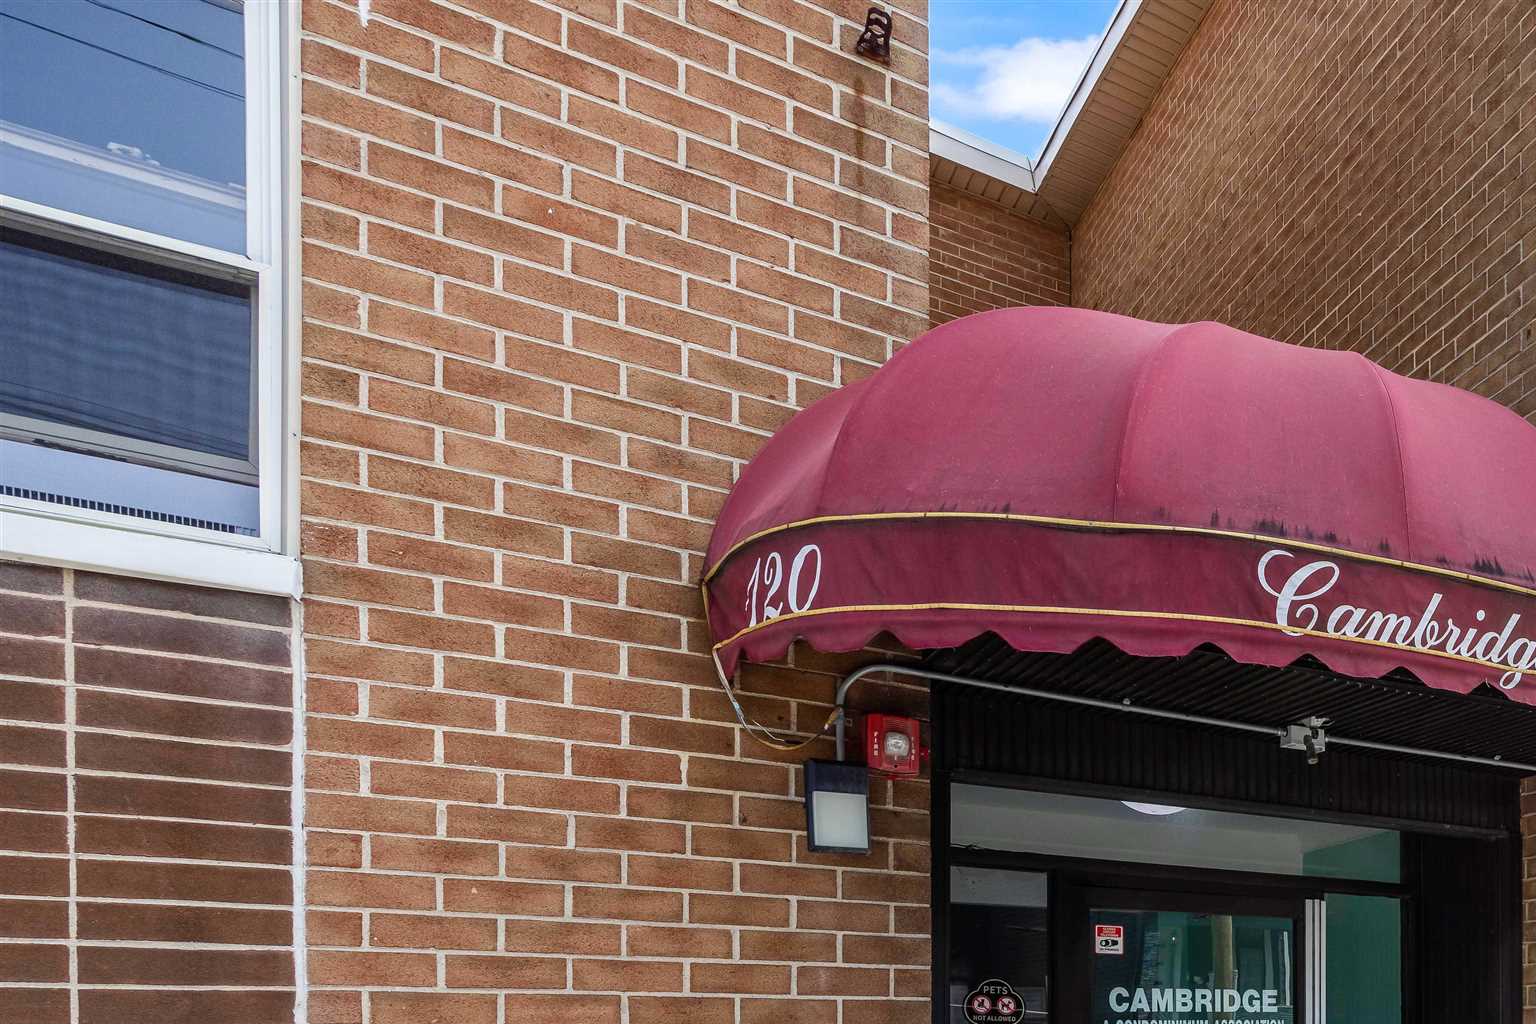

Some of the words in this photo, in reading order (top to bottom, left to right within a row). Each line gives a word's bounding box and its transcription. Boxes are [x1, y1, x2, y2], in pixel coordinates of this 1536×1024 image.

[745, 544, 822, 628] 120
[983, 985, 1008, 995] PETS
[1108, 986, 1279, 1013] CAMBRIDGE
